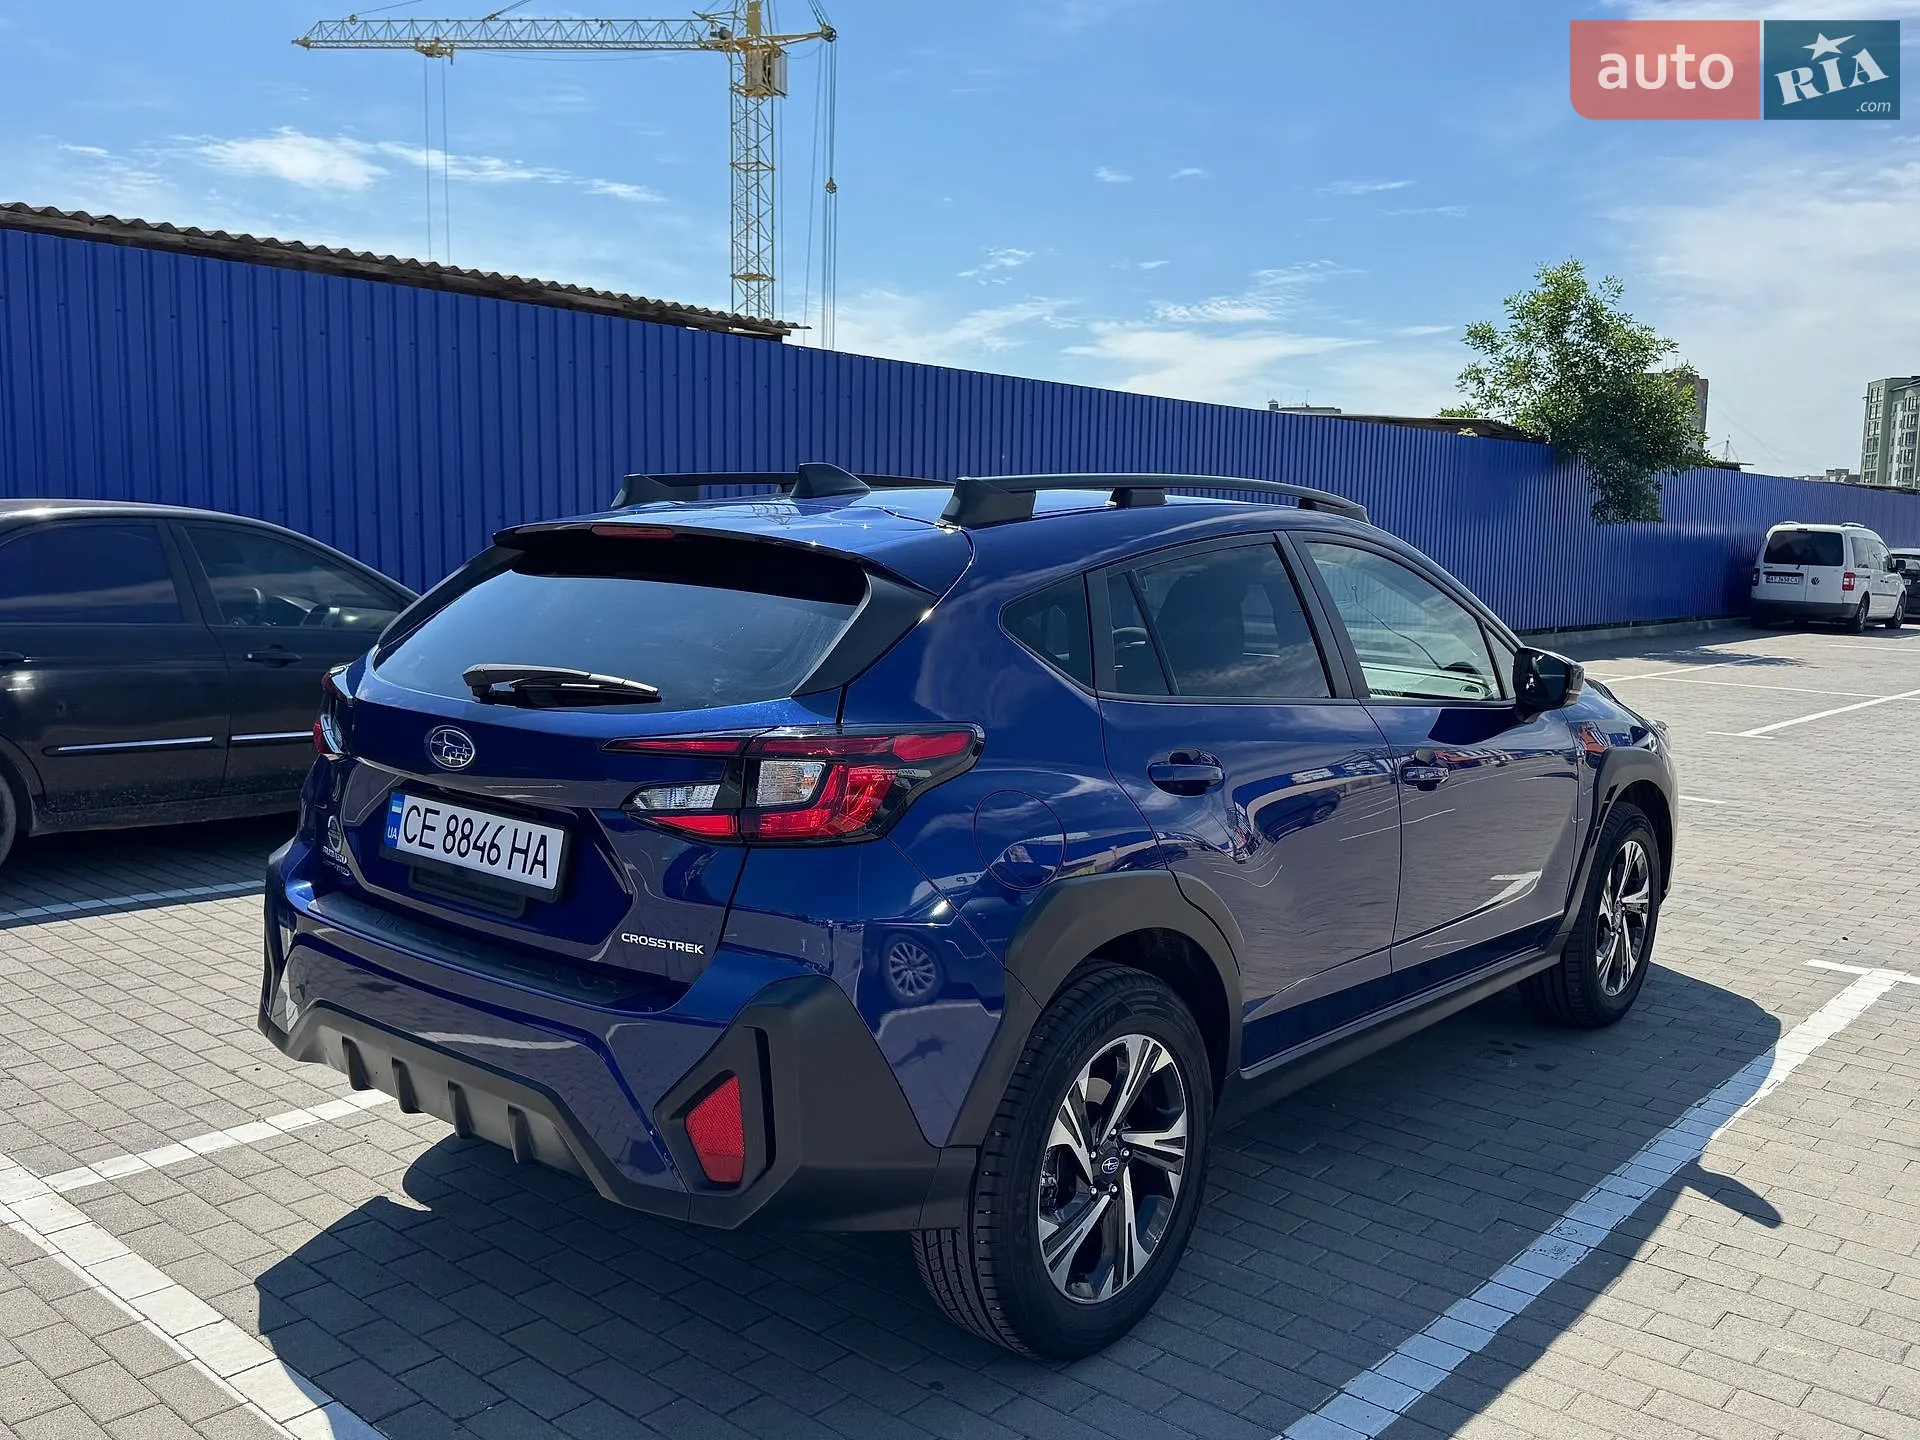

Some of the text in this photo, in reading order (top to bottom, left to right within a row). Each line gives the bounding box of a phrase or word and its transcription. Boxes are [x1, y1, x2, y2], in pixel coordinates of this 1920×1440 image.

[387, 826, 397, 840] UA
[403, 804, 547, 879] CE 8846 HA
[621, 933, 705, 955] CROSSTREK
